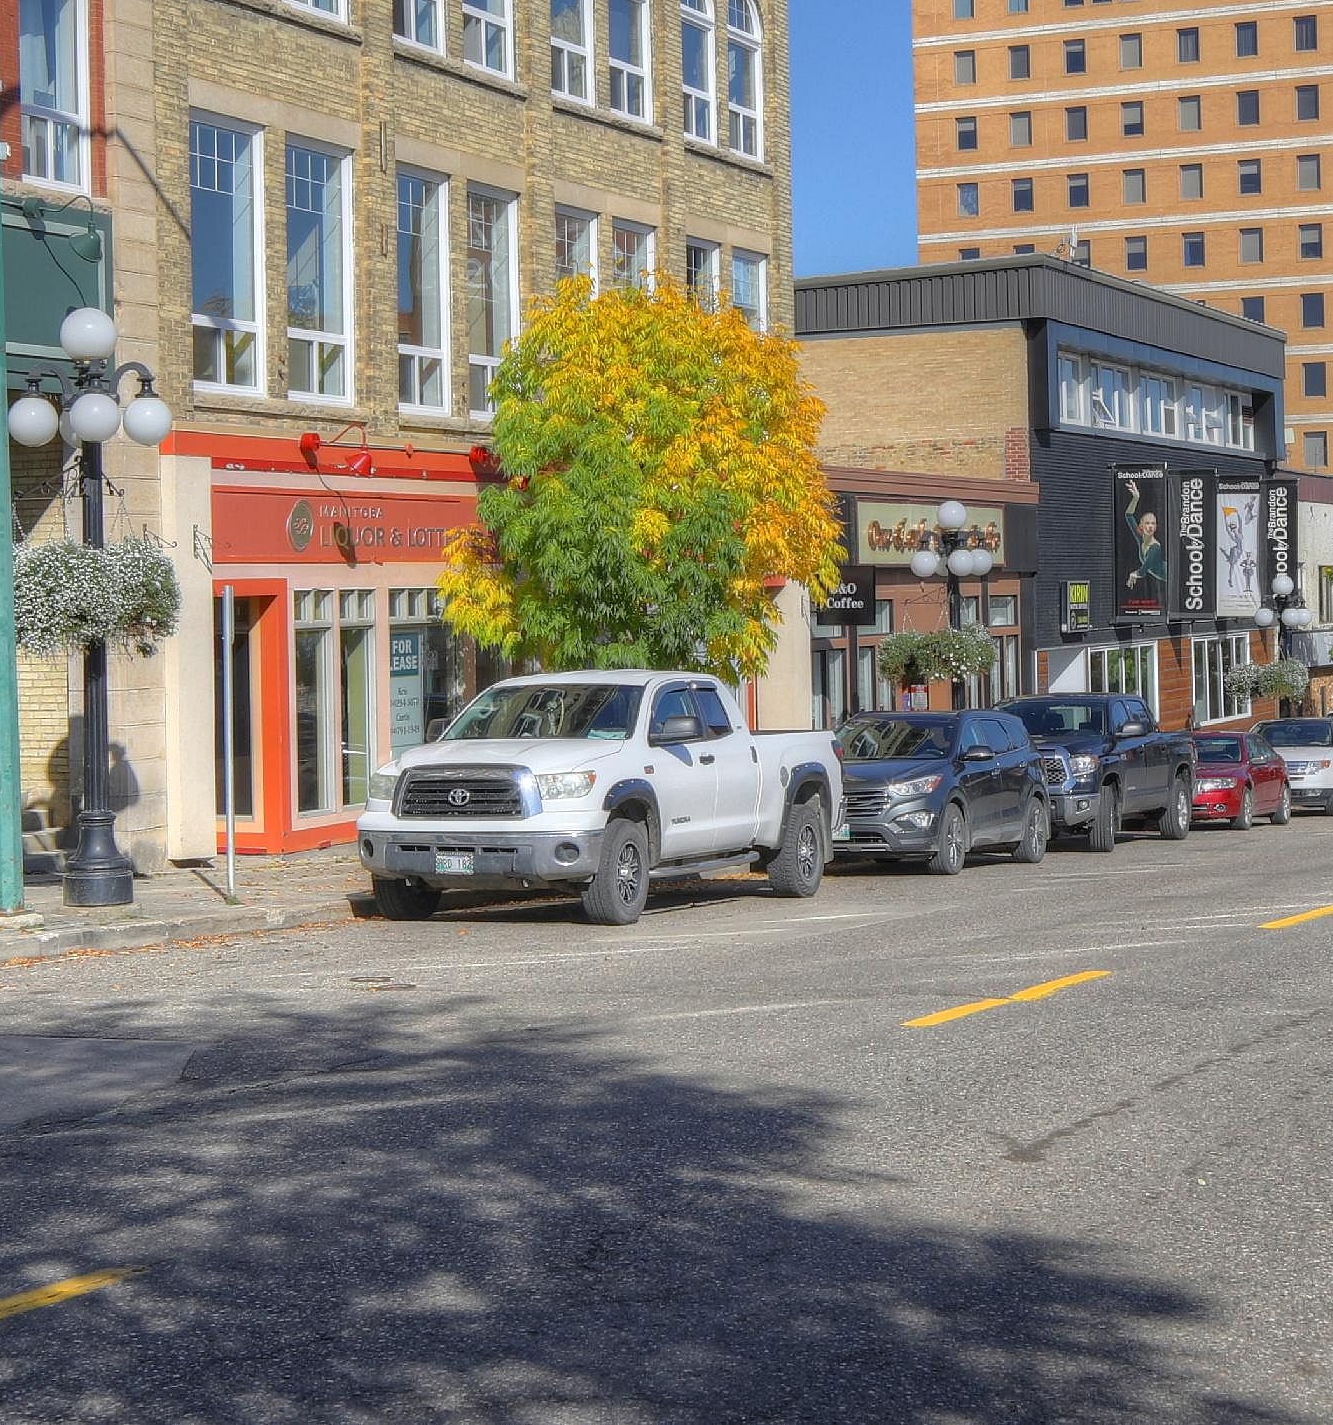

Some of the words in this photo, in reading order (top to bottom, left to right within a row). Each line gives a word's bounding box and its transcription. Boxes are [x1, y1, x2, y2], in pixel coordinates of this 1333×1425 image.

[1181, 481, 1190, 524] Brandon
[1187, 478, 1204, 538] Dance
[1268, 489, 1276, 528] Brandon
[1273, 486, 1288, 540] Dance
[320, 526, 385, 549] LIQUOR
[390, 526, 403, 547] &
[1185, 545, 1204, 610] School
[827, 597, 864, 609] Coffee
[392, 639, 412, 654] FOR
